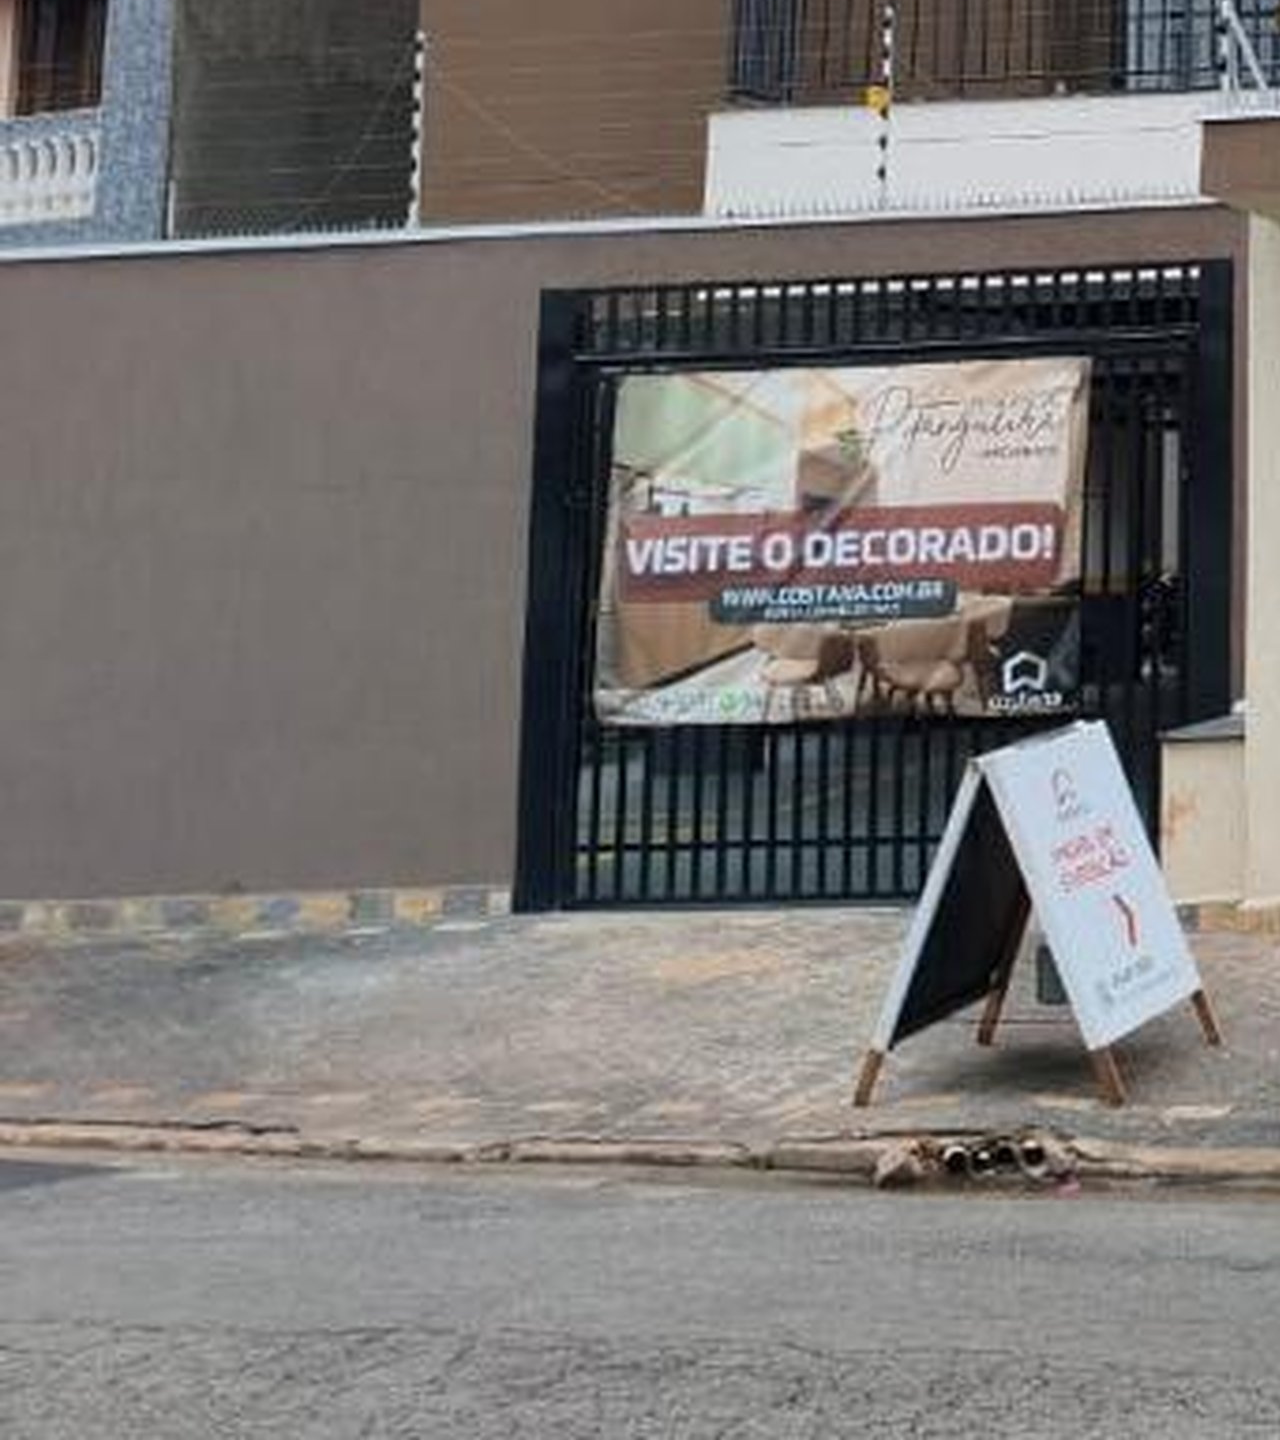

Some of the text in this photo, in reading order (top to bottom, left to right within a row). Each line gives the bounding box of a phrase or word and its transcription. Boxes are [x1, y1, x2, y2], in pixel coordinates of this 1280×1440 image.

[626, 522, 1055, 576] VISITE O DECORADO!
